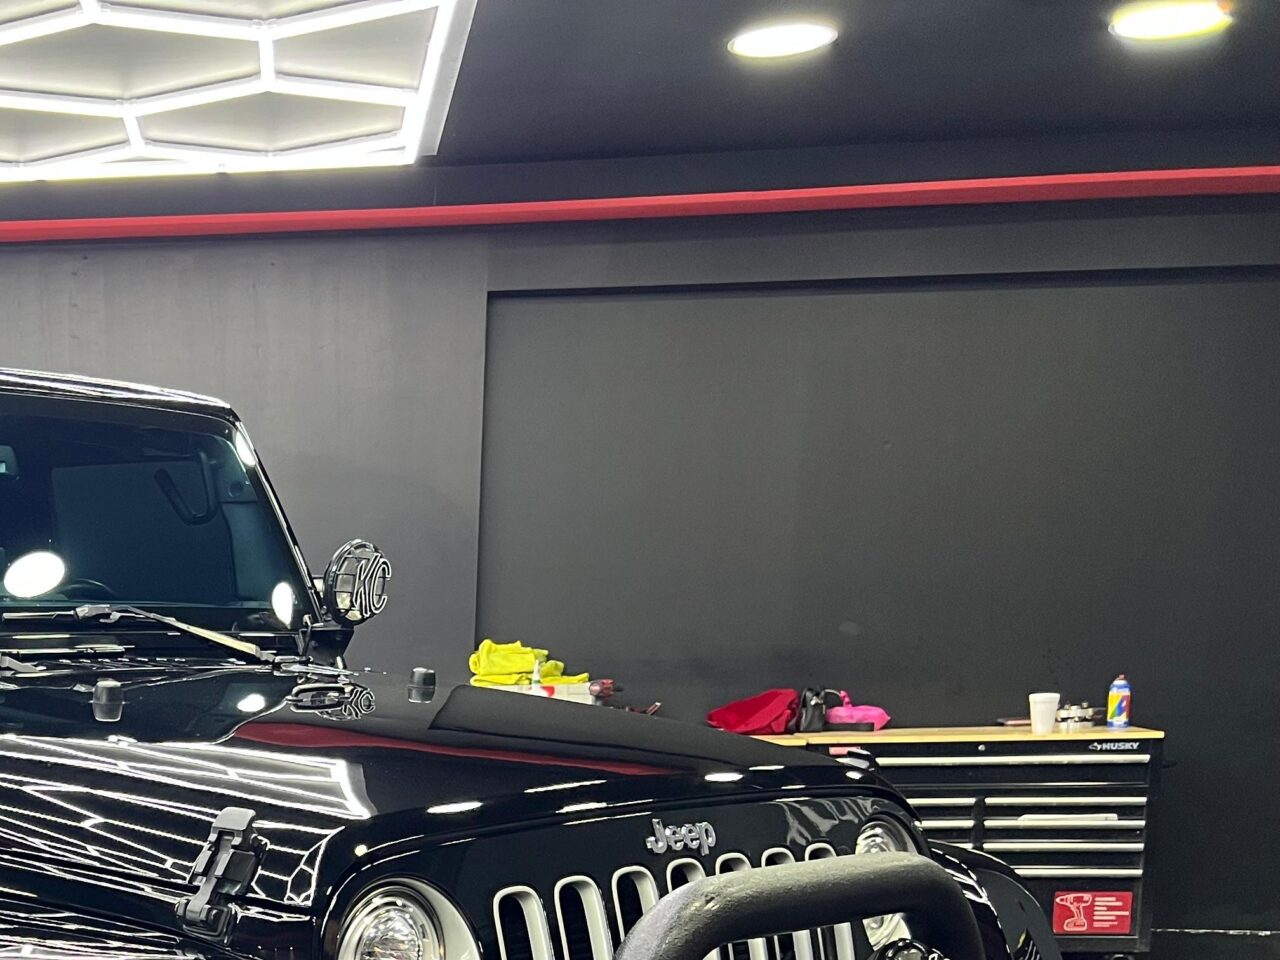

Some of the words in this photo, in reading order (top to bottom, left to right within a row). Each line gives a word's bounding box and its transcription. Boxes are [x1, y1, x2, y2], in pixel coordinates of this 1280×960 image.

[352, 552, 392, 619] KC
[1102, 742, 1140, 751] HUSKY
[646, 818, 716, 856] Jeep
